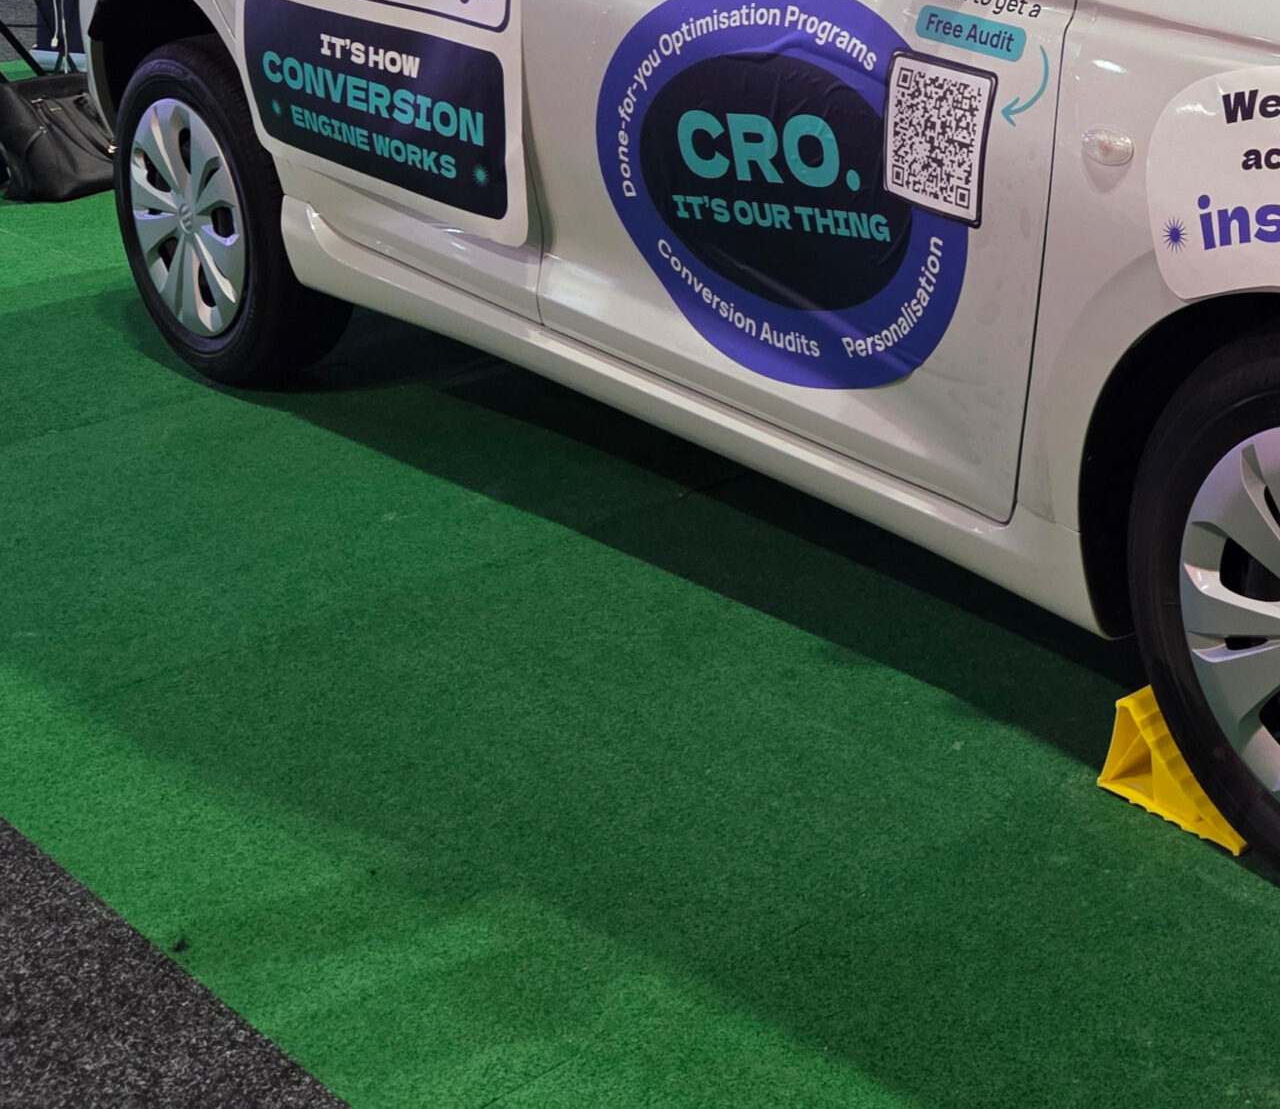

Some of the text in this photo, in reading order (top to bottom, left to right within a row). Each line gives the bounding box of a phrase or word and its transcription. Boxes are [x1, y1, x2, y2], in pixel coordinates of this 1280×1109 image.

[925, 14, 1015, 53] Free Audit
[1028, 3, 1042, 19] a
[320, 33, 420, 78] IT'S HOW
[262, 50, 484, 147] CONVERSION
[612, 3, 878, 198] Done-for-you Optimisation Programs
[292, 105, 457, 179] ENGINE WORKS
[677, 109, 861, 192] CRO.
[673, 194, 891, 243] IT'S OUR THING
[657, 239, 820, 358] Conversion Audits
[841, 236, 944, 359] Personalisation
